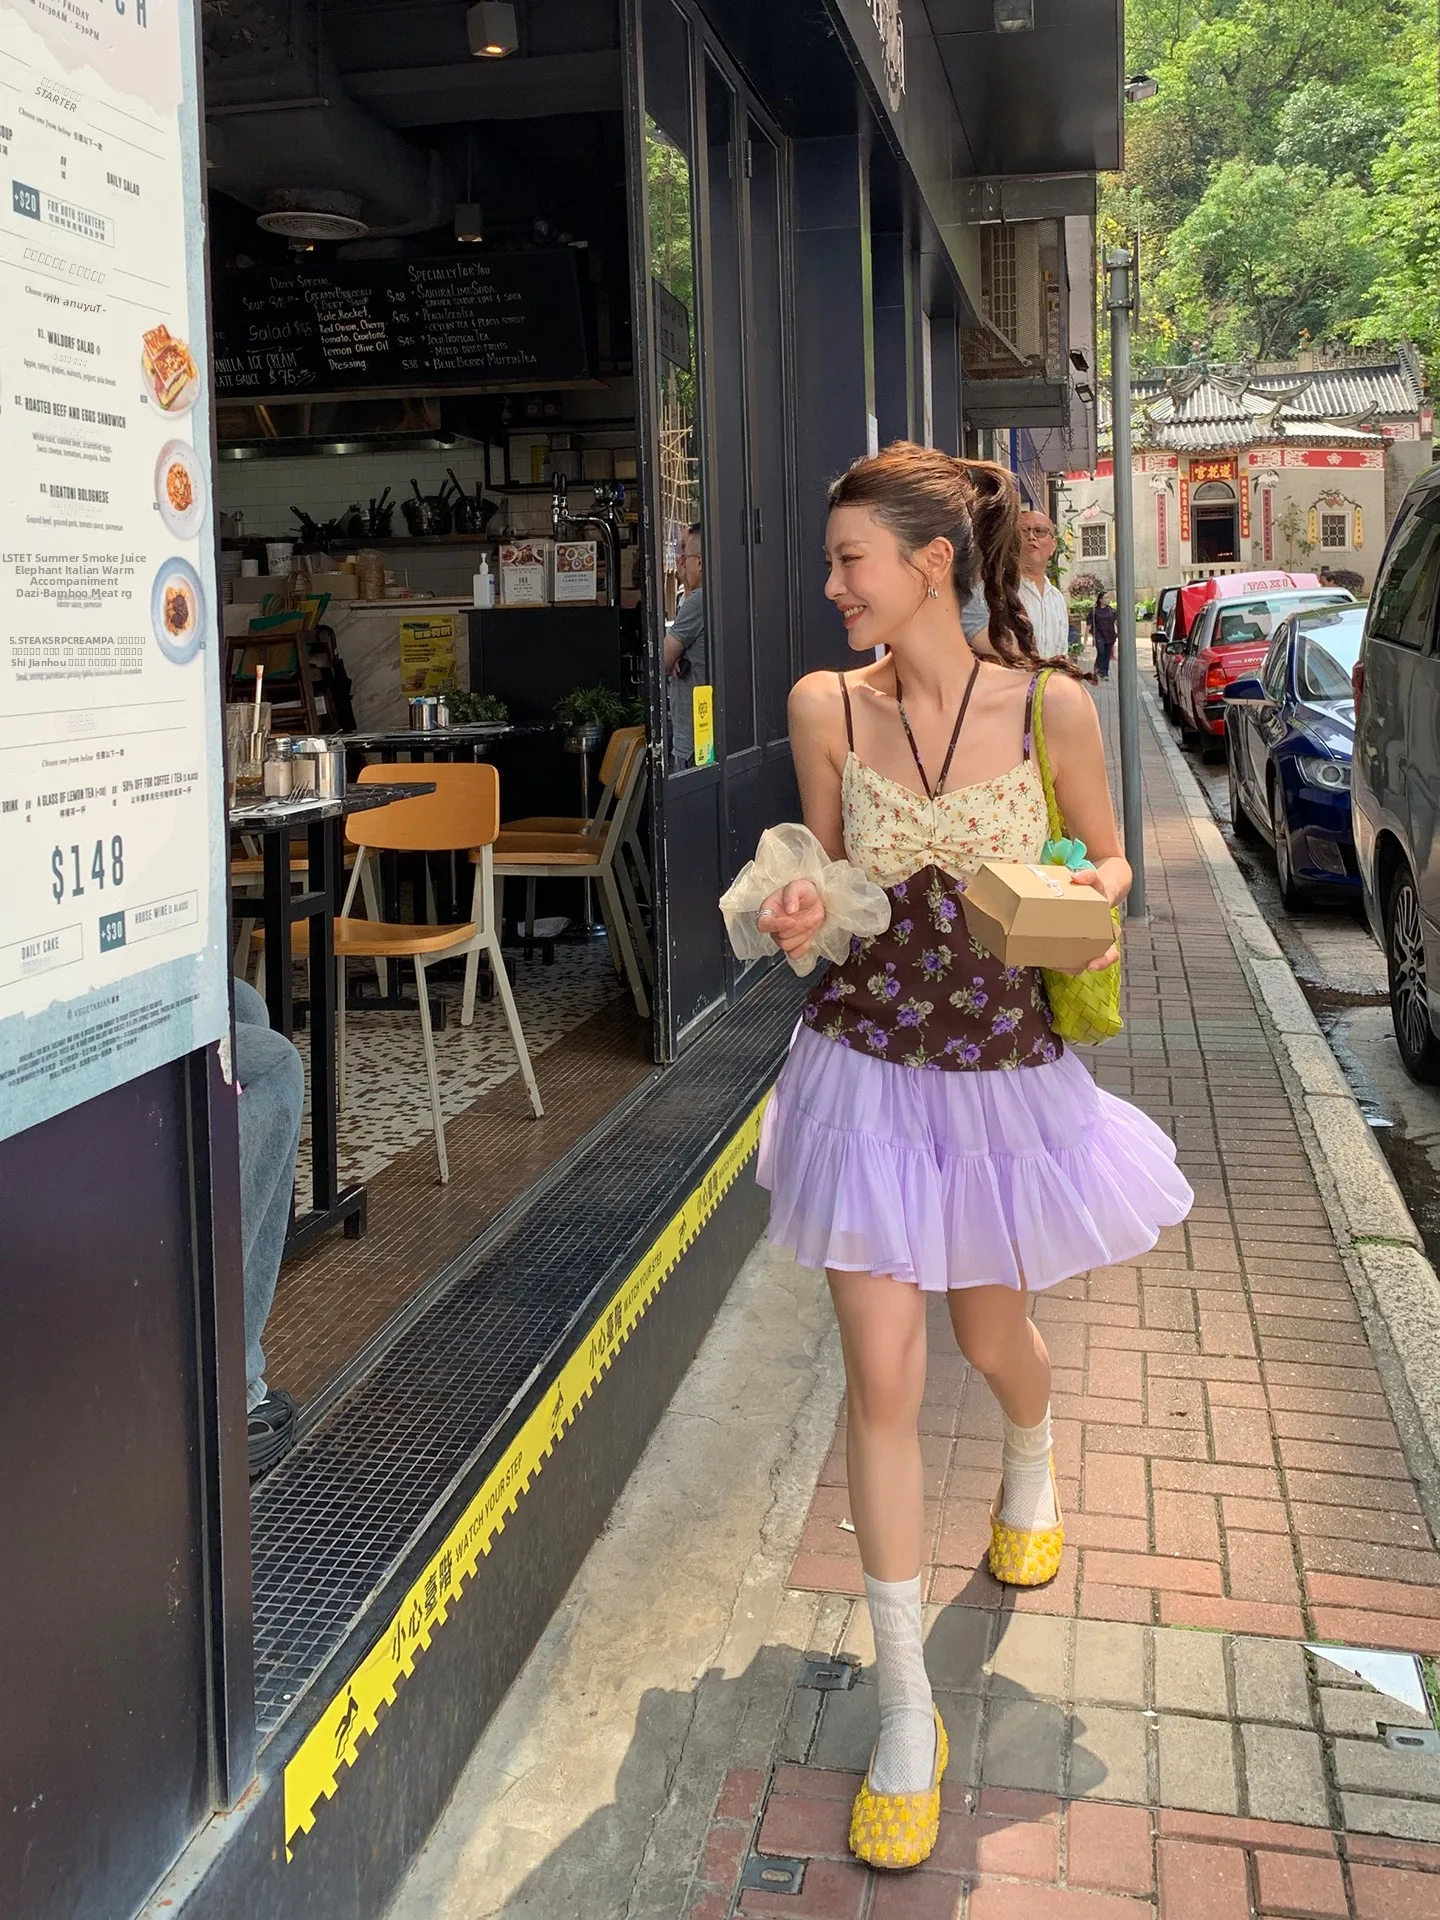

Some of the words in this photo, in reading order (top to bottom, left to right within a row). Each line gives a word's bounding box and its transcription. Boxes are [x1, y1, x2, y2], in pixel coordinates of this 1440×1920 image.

[62, 0, 90, 21] FRIDAY
[38, 2, 67, 23] 11:30AM
[75, 22, 100, 41] 2:30PM
[34, 86, 77, 112] STARTER
[106, 172, 121, 189] DAILY
[124, 178, 140, 196] SALAD
[14, 190, 36, 212] +$20
[48, 200, 58, 213] FOR
[61, 204, 75, 220] BOTH
[78, 212, 105, 231] STARTERS
[297, 275, 331, 288] SPECIAL
[408, 265, 458, 282] SPECIALLY
[457, 262, 475, 278] FOR
[473, 262, 491, 276] YOU
[417, 284, 452, 299] SAKURA
[451, 284, 473, 296] LIME
[472, 280, 496, 295] SODA
[461, 307, 475, 318] TEA
[248, 322, 292, 342] Salad
[319, 324, 334, 334] Red
[443, 333, 476, 345] TROPICAL
[475, 329, 490, 341] TEA
[47, 330, 75, 349] WALDORF
[76, 338, 94, 354] SALAD
[323, 346, 352, 357] lemon
[355, 344, 374, 353] Olive
[376, 340, 389, 351] Oil
[435, 346, 458, 356] MIXED
[215, 357, 244, 373] ANILLA
[248, 355, 263, 370] ICE
[266, 352, 297, 369] CREAM
[487, 352, 521, 366] MUFFIN
[520, 351, 537, 363] TEA
[216, 375, 235, 387] LATE
[236, 373, 260, 386] SAUCE
[25, 397, 51, 415] ROASTED
[53, 403, 67, 418] BEEF
[69, 406, 80, 420] AND
[82, 408, 96, 423] EGGS
[97, 412, 126, 429] SANDWICH
[50, 484, 76, 500] RIGATONI
[78, 488, 109, 504] BOLOGNESE
[35, 554, 79, 562] Summer
[82, 554, 119, 562] Smoke
[120, 553, 147, 564] Juice
[15, 566, 62, 576] Elephant
[65, 566, 99, 574] Italian
[102, 566, 134, 574] Warm
[30, 576, 119, 587] Accompaniment
[1248, 579, 1288, 590] TAXI
[92, 588, 119, 598] Meat
[11, 658, 26, 667] Shi
[28, 658, 66, 668] Jianhou
[42, 759, 58, 768] Choose
[68, 756, 79, 766] from
[80, 754, 94, 763] below
[122, 780, 134, 792] 50%
[134, 778, 143, 790] OFF
[144, 777, 153, 788] FOR
[154, 774, 170, 786] COFFEE
[174, 772, 182, 783] TEA
[42, 793, 58, 807] GLASS
[59, 792, 66, 803] OF
[67, 789, 84, 802] LEMON
[85, 787, 94, 799] TEA
[52, 835, 124, 904] $148
[135, 909, 152, 924] HOUSE
[154, 905, 168, 918] WINE
[101, 921, 123, 942] +$30
[22, 942, 40, 960] DAILY
[43, 937, 59, 953] CAKE
[74, 998, 111, 1017] VEGETARIAN
[624, 1281, 640, 1314] WATCH
[640, 1265, 652, 1289] YOUR
[652, 1251, 662, 1272] STEP
[392, 1548, 452, 1663] 小心臺階
[456, 1509, 484, 1563] WATCH
[485, 1478, 505, 1518] YOUR
[506, 1451, 522, 1487] STEP
